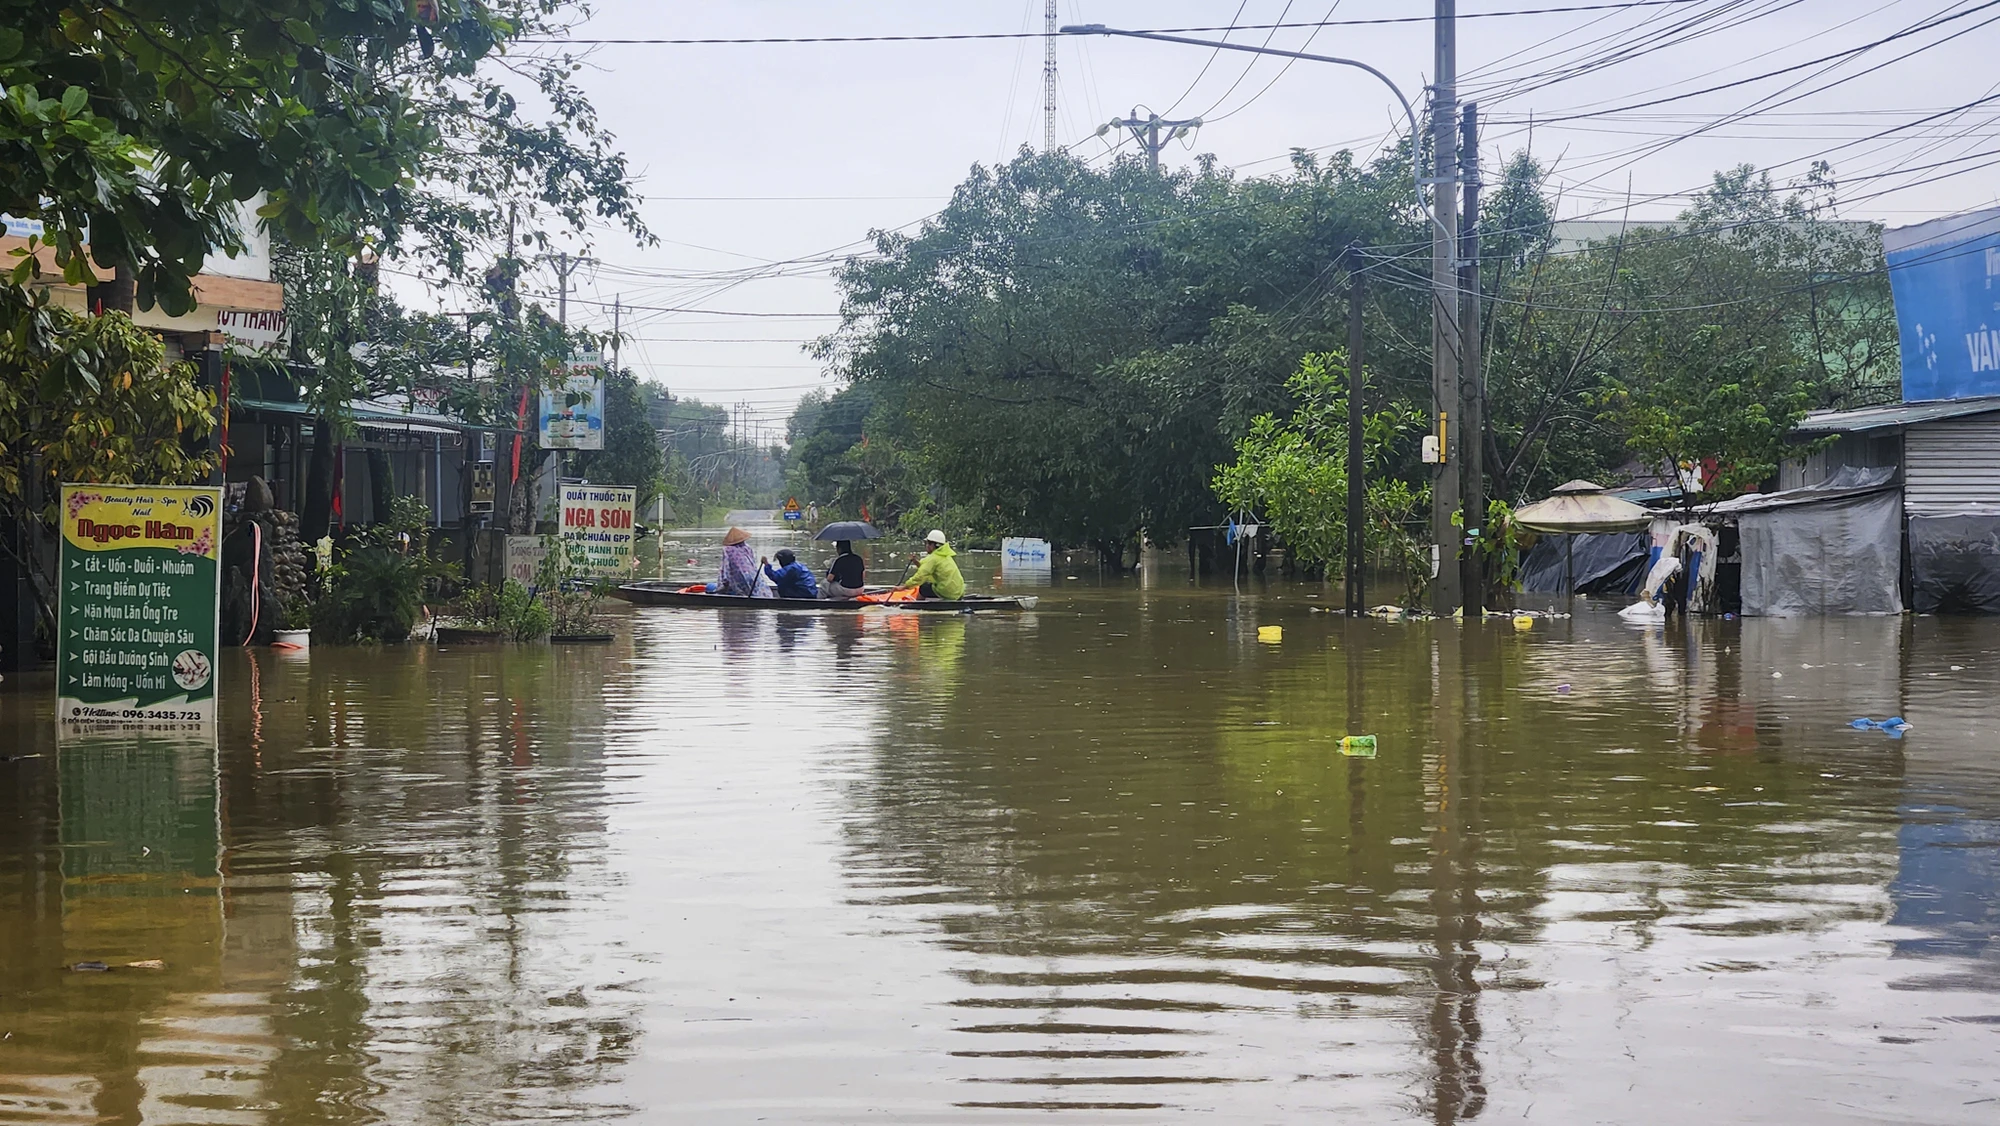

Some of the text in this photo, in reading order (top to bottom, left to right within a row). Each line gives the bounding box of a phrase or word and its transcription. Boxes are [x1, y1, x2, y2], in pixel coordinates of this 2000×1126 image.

[104, 495, 133, 506] Beauty
[135, 495, 154, 504] Hair
[161, 496, 178, 508] Spa
[590, 490, 615, 502] THUỐC
[617, 492, 632, 503] TÂY
[132, 508, 152, 516] Nail
[565, 507, 632, 529] NGA SƠN
[77, 518, 194, 543] Ngọc Hân
[613, 534, 631, 543] GPP
[588, 544, 612, 555] HÀNH
[614, 544, 629, 556] TỐT
[84, 555, 100, 572] Cắt
[108, 556, 126, 573] Uốn
[134, 556, 154, 574] Duỗi
[162, 560, 194, 577] Nhuộm
[84, 577, 171, 600] Trang Điểm Dự Tiệc
[84, 600, 178, 624] Nặn Mụn Lăn Ống Tre
[83, 626, 194, 648] Chăm Sóc Da Chuyên Sâu
[82, 649, 97, 667] Gội
[118, 650, 147, 670] Dưỡng
[149, 651, 169, 667] Sinh
[82, 672, 101, 688] Làm
[103, 673, 127, 693] Móng
[135, 672, 153, 689] Uốn
[155, 675, 166, 689] Mi
[122, 709, 201, 721] 096.3435.723
